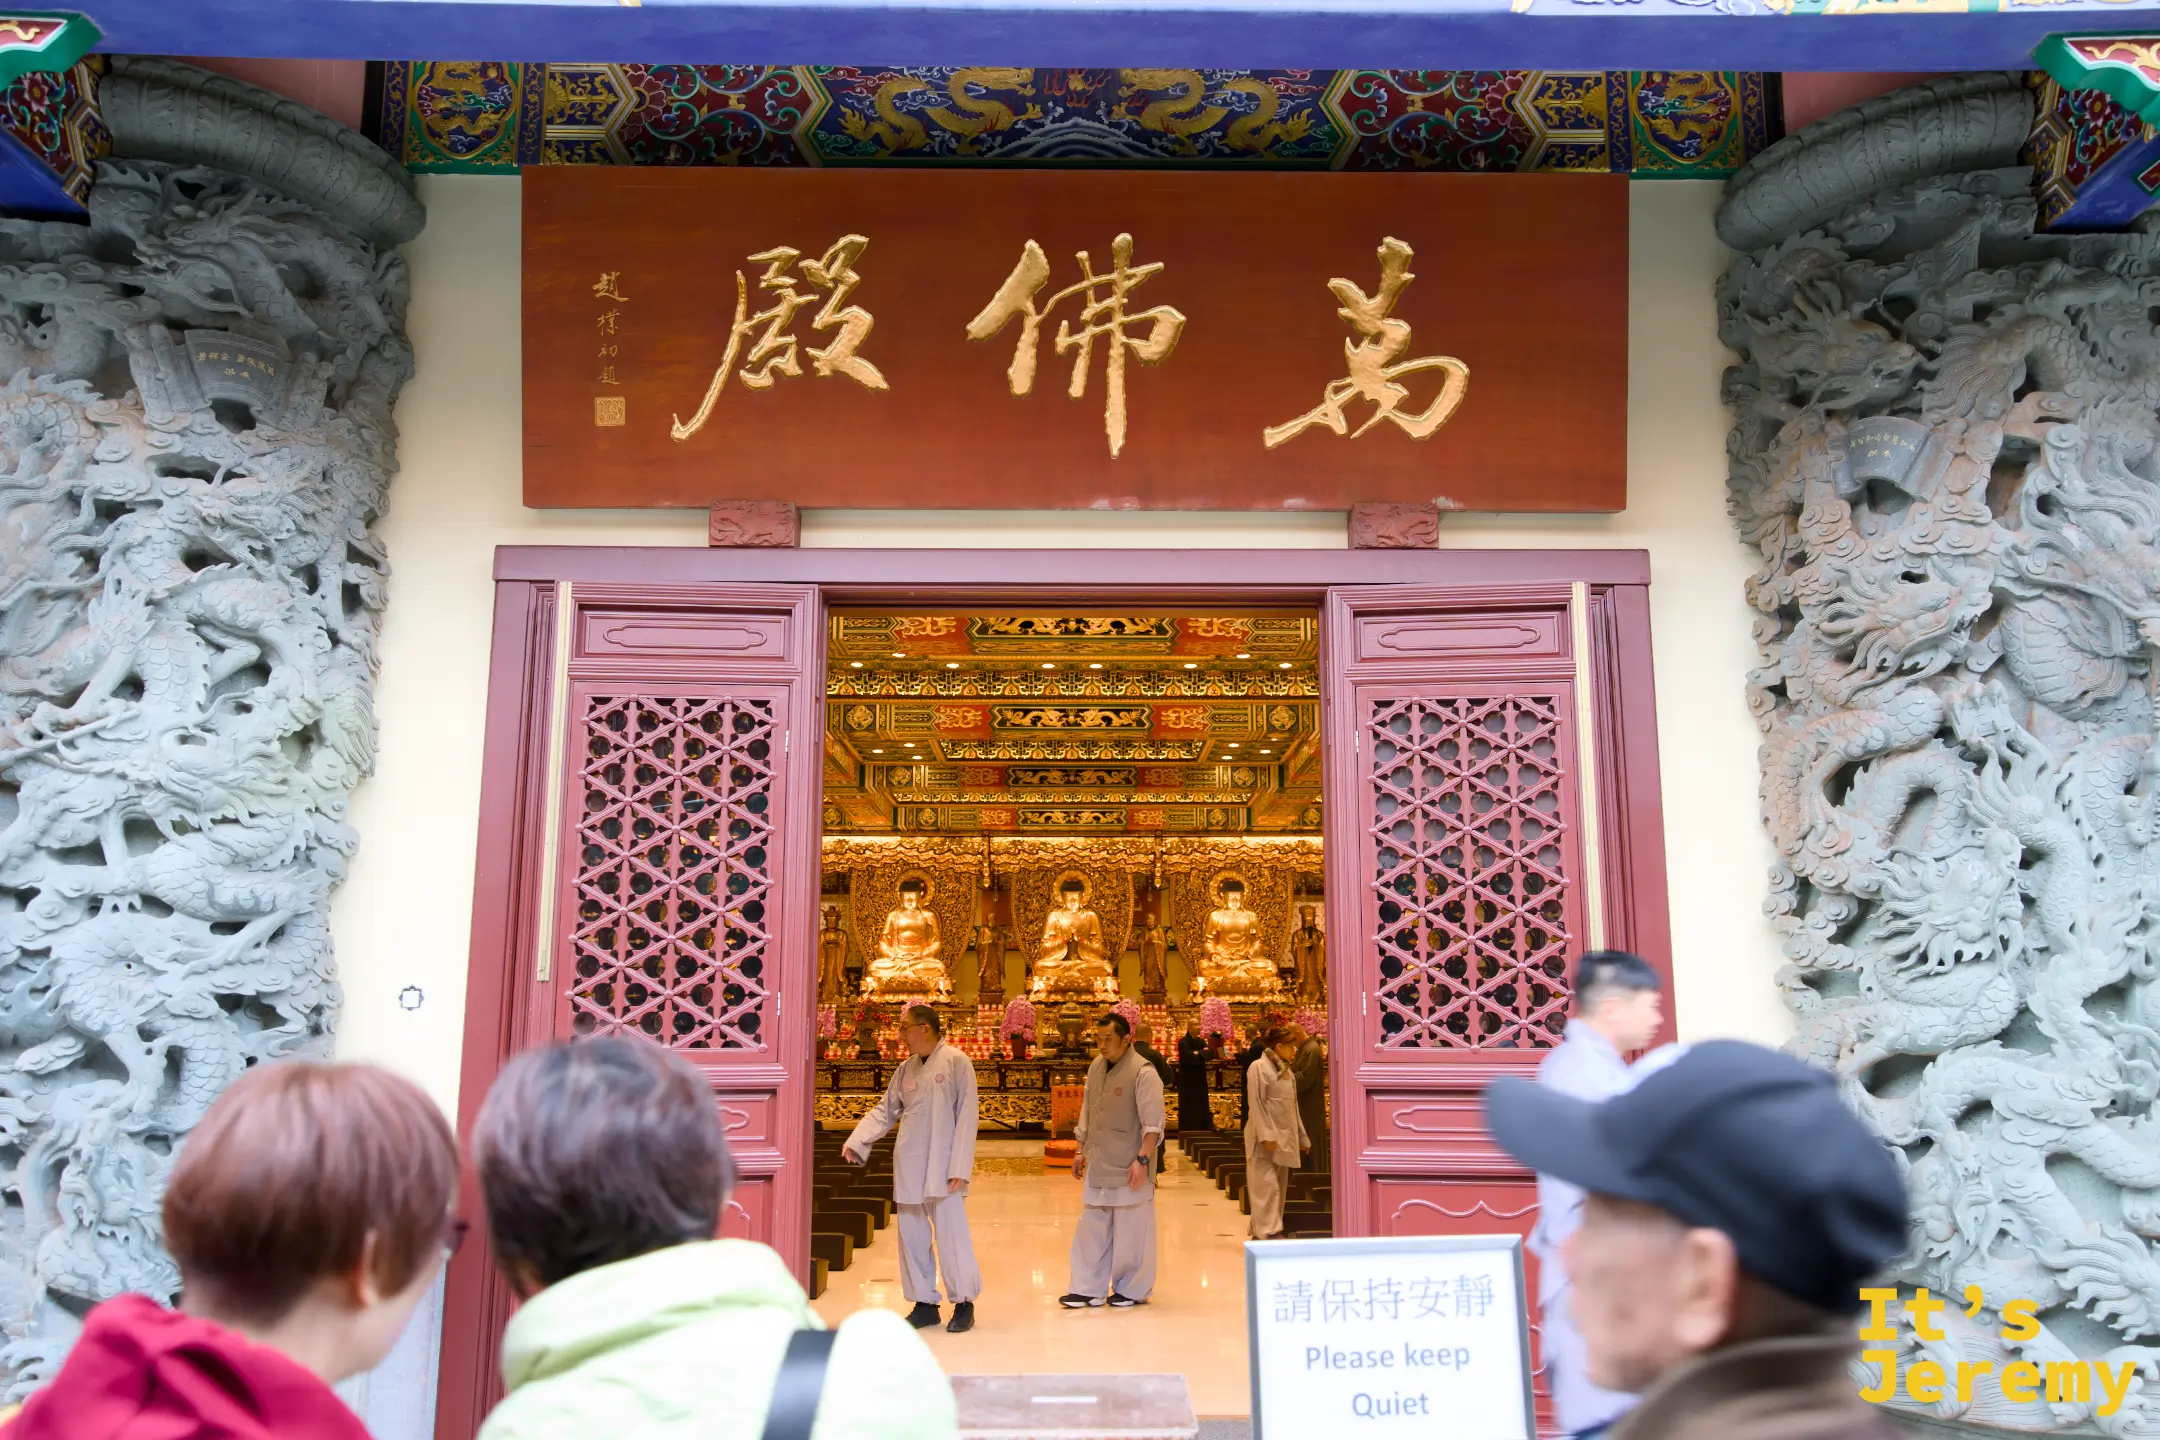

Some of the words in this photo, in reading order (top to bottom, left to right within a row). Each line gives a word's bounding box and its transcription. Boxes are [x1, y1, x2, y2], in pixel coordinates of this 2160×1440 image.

[1273, 1274, 1495, 1323] 請保持安靜
[1305, 1345, 1395, 1371] Please
[1404, 1342, 1471, 1371] keep
[1352, 1391, 1430, 1420] Quiet
